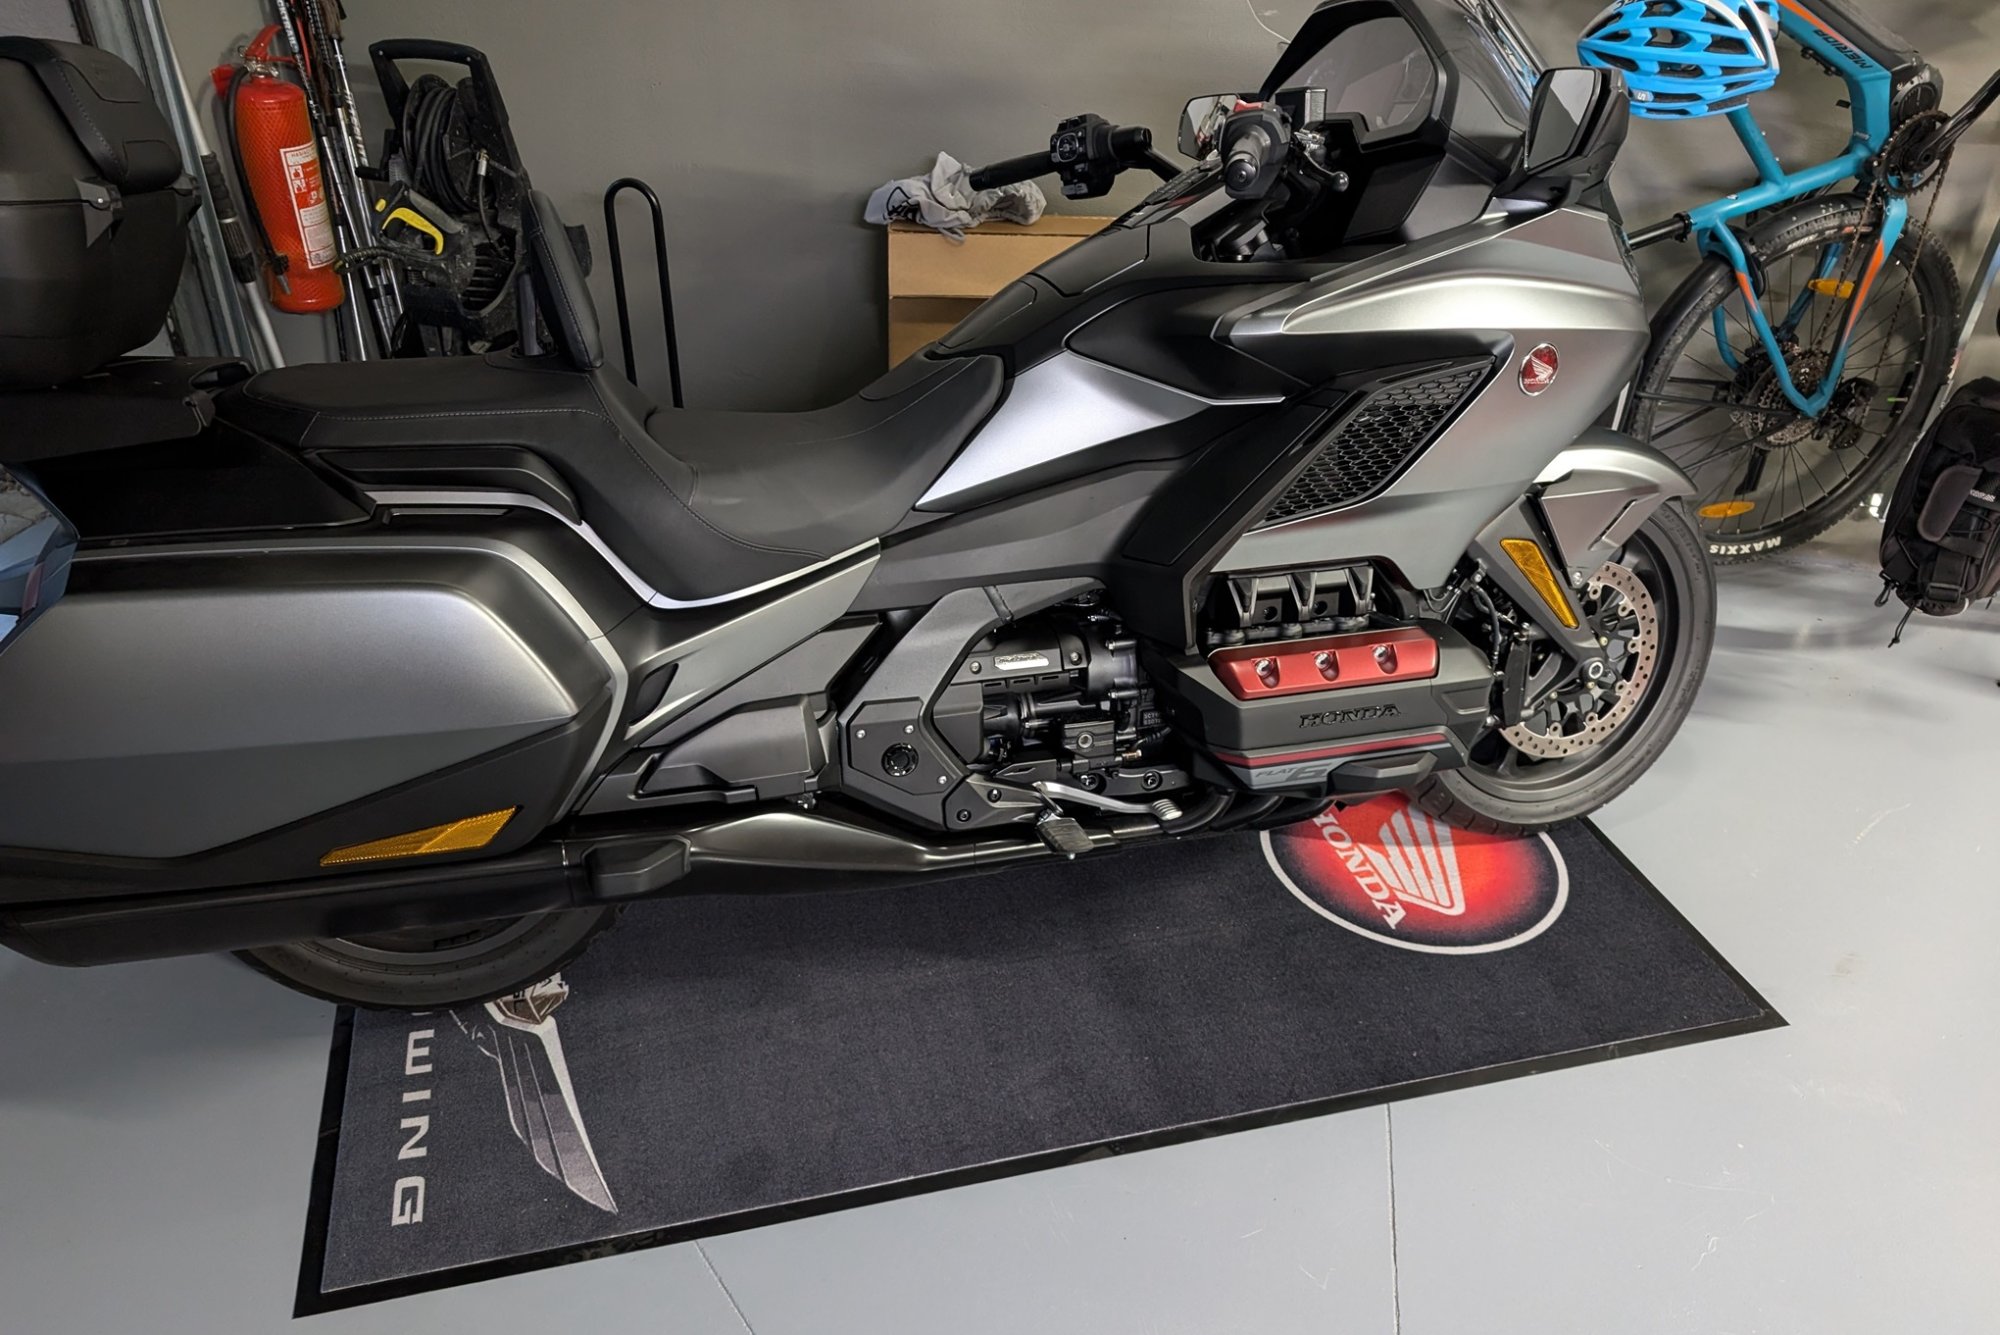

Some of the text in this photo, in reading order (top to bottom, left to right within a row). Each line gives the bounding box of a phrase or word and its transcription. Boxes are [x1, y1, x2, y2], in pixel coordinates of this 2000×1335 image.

[1813, 29, 1873, 69] MERIDA
[1709, 535, 1782, 555] MAXXIS
[1299, 703, 1401, 728] HONDA
[1255, 767, 1297, 778] FLAT
[391, 1011, 435, 1227] WING
